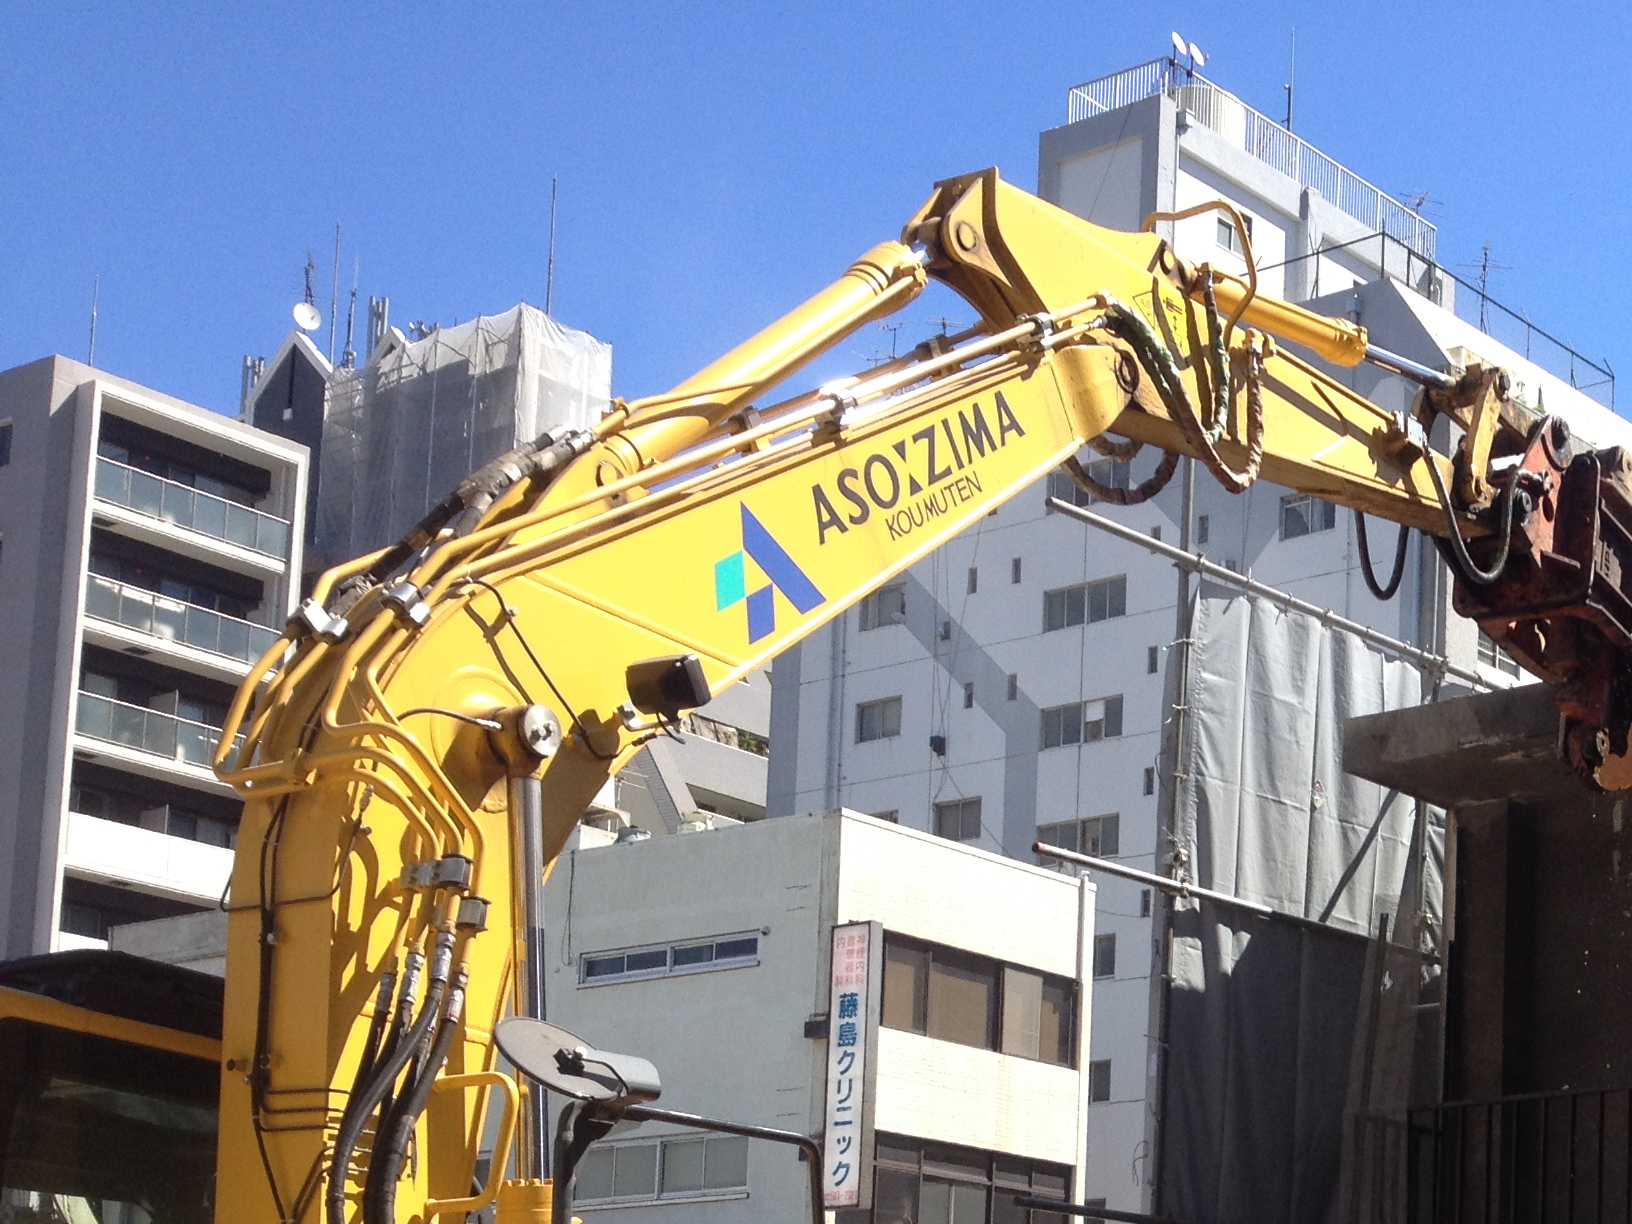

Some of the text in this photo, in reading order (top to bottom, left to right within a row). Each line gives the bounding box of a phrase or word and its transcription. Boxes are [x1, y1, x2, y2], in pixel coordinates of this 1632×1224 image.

[885, 470, 983, 541] KOUMUTEN
[832, 992, 859, 1187] 藤島クリニック
